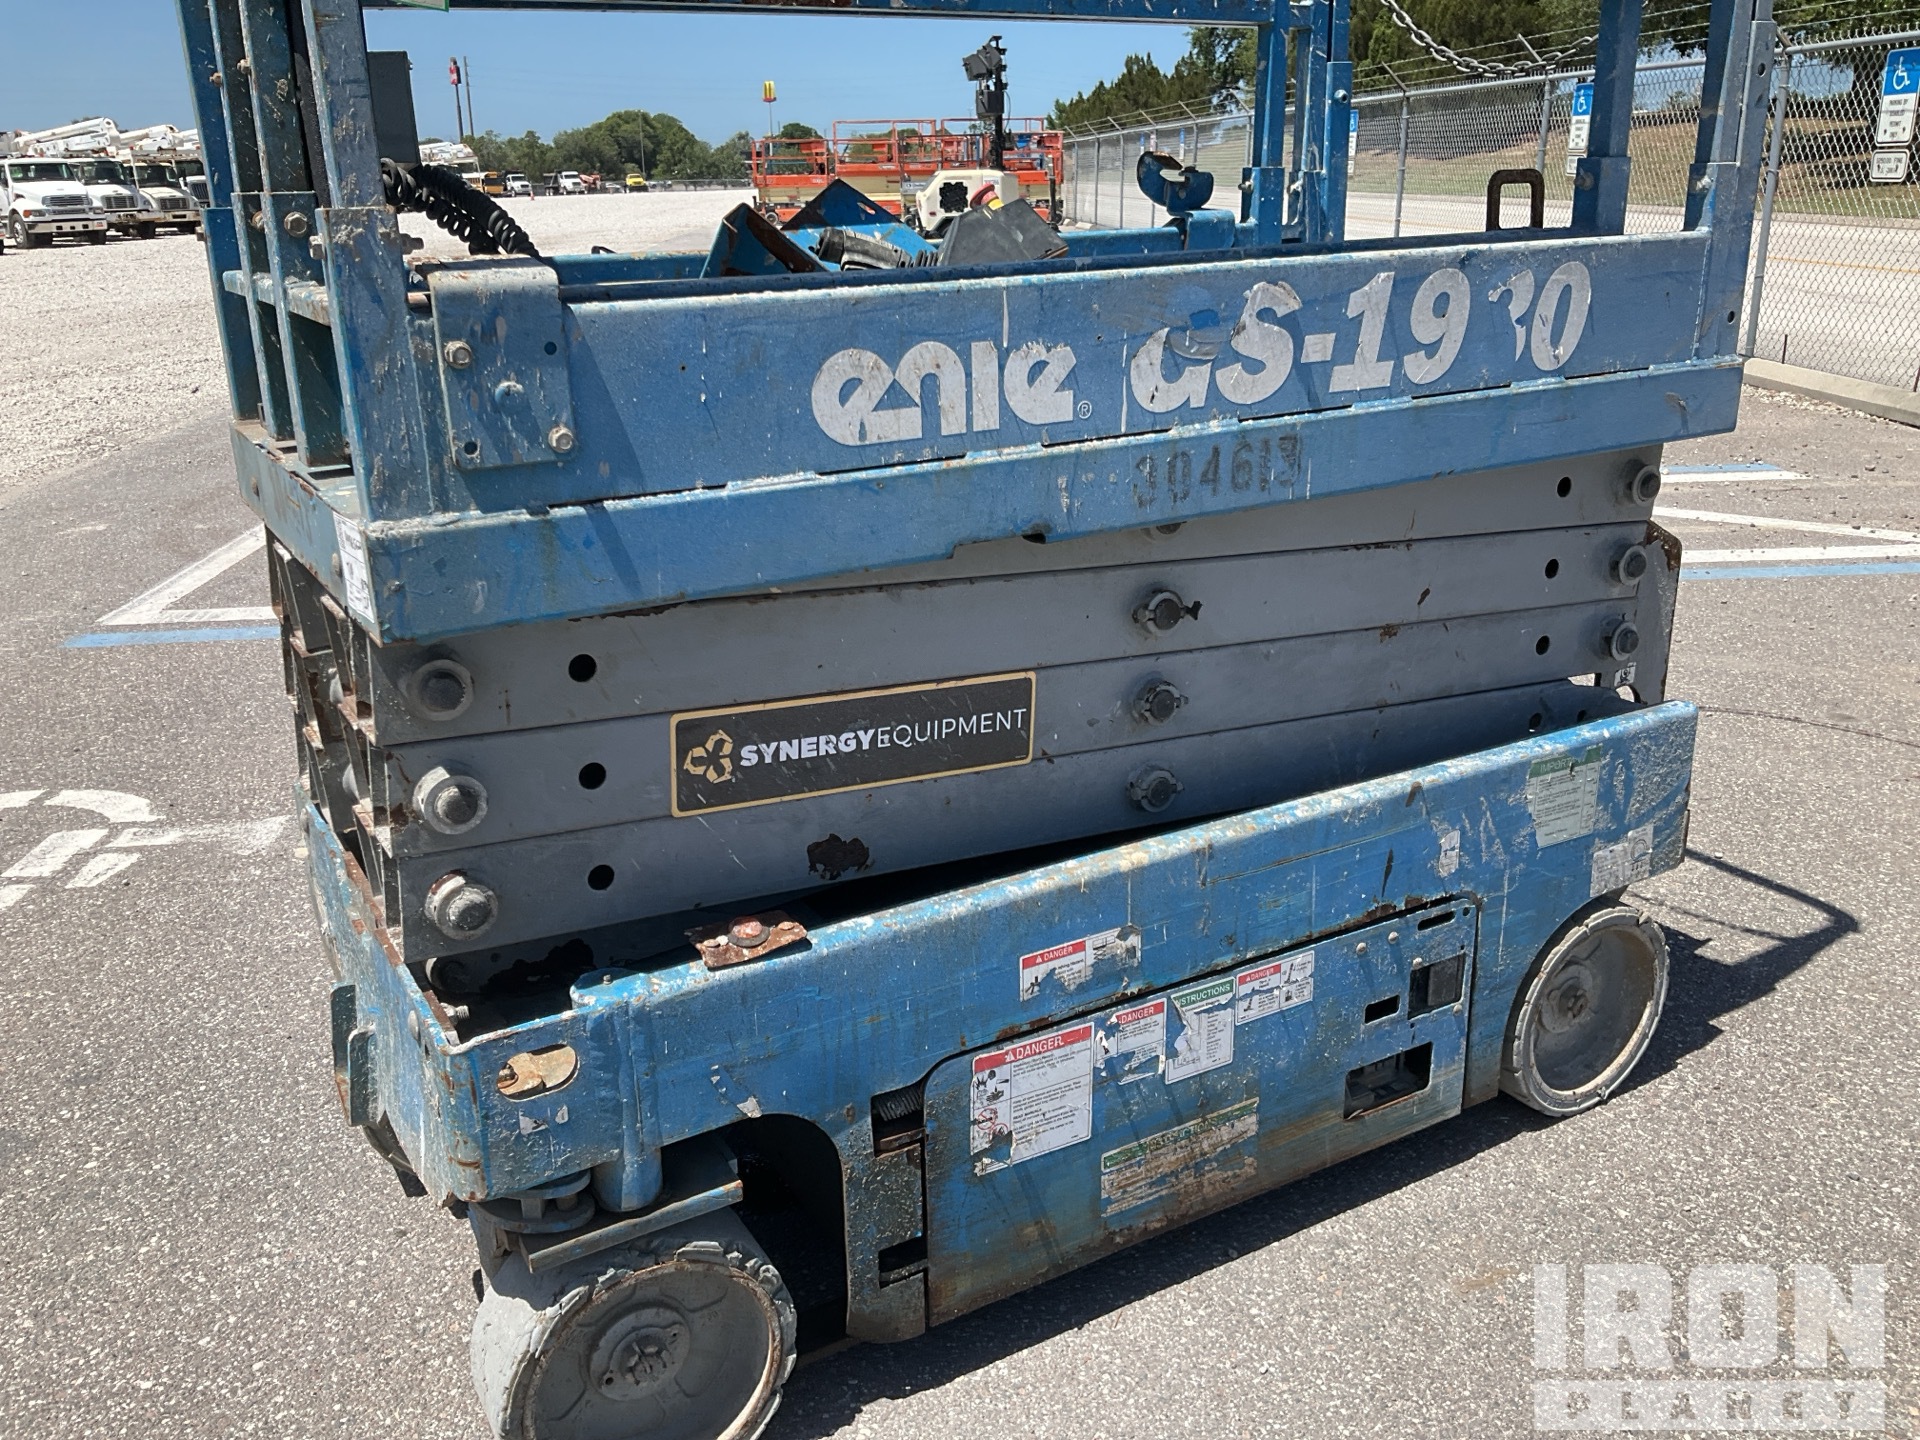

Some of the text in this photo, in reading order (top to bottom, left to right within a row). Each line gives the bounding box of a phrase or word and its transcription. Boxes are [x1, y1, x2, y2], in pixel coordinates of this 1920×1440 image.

[1044, 945, 1073, 960] DANGER
[1250, 967, 1274, 980] DANGER
[1121, 1006, 1154, 1023] DANGER
[1016, 1036, 1065, 1059] DANGER
